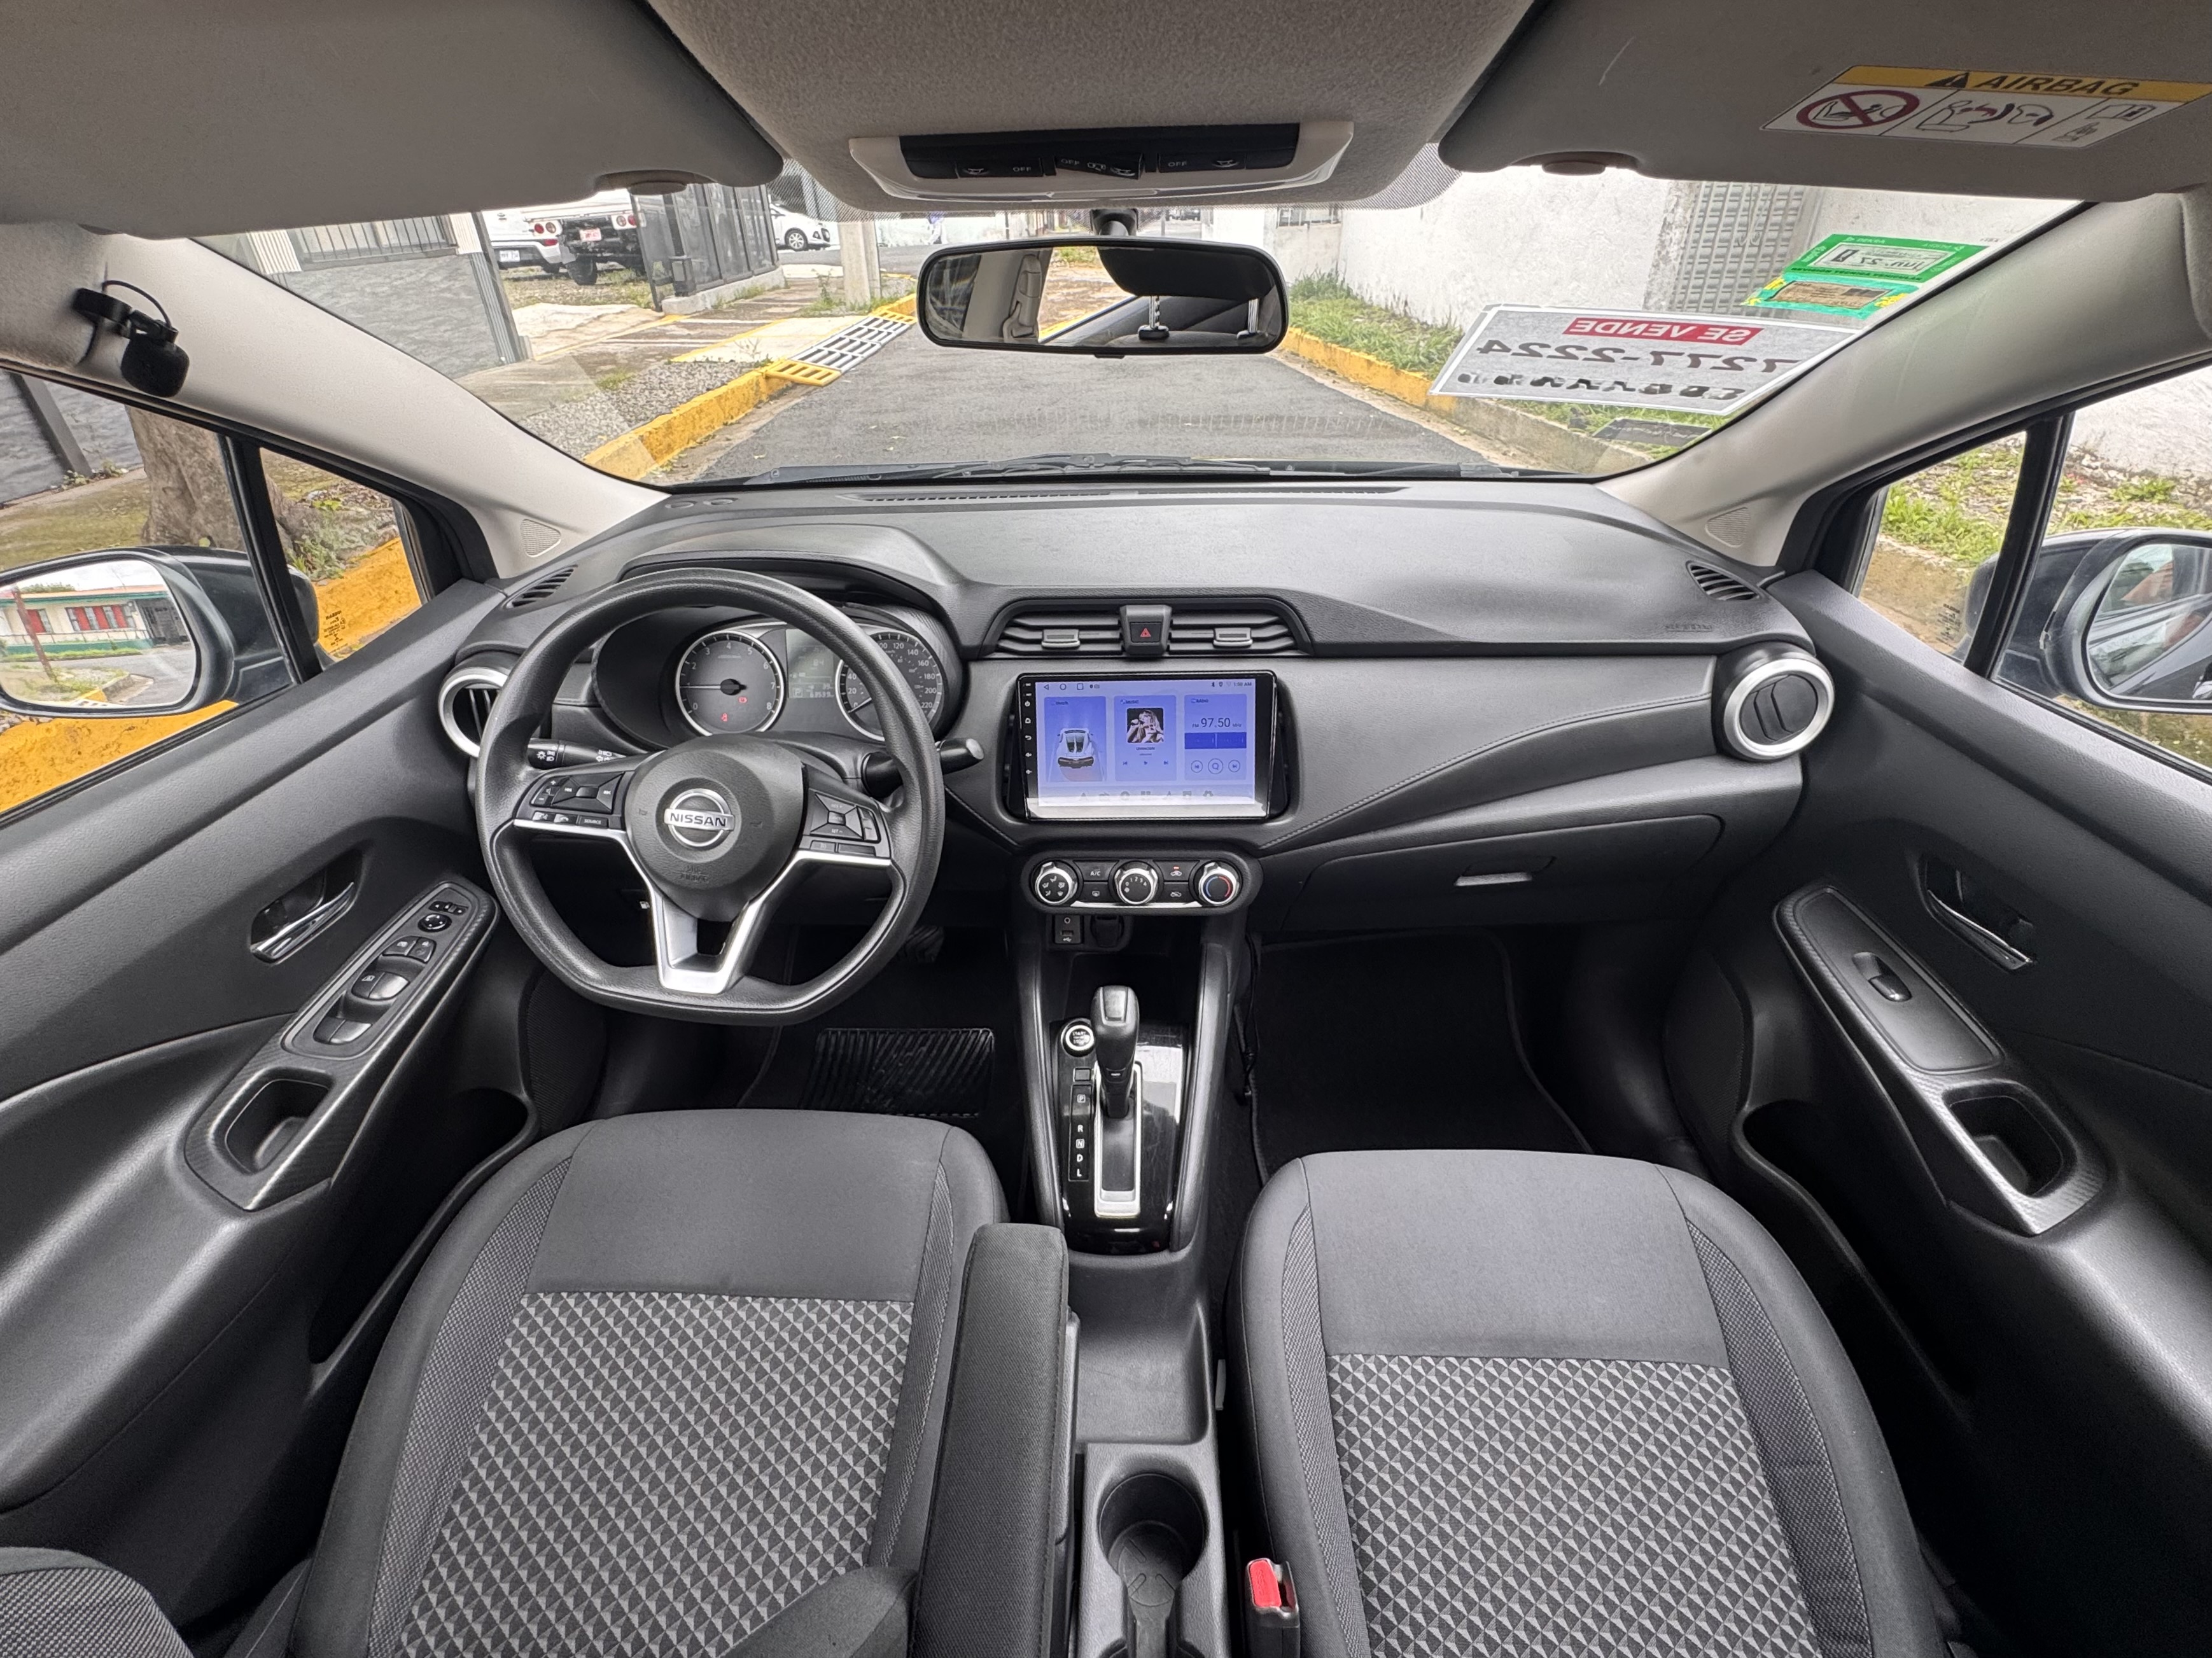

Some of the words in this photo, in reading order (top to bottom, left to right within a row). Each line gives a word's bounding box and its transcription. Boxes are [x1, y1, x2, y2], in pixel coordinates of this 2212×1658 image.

[1973, 75, 2140, 95] AIRBAG
[1201, 718, 1231, 728] 97.50
[669, 812, 727, 827] NISSAN
[1077, 1154, 1084, 1162] D
[1077, 1169, 1082, 1177] L
